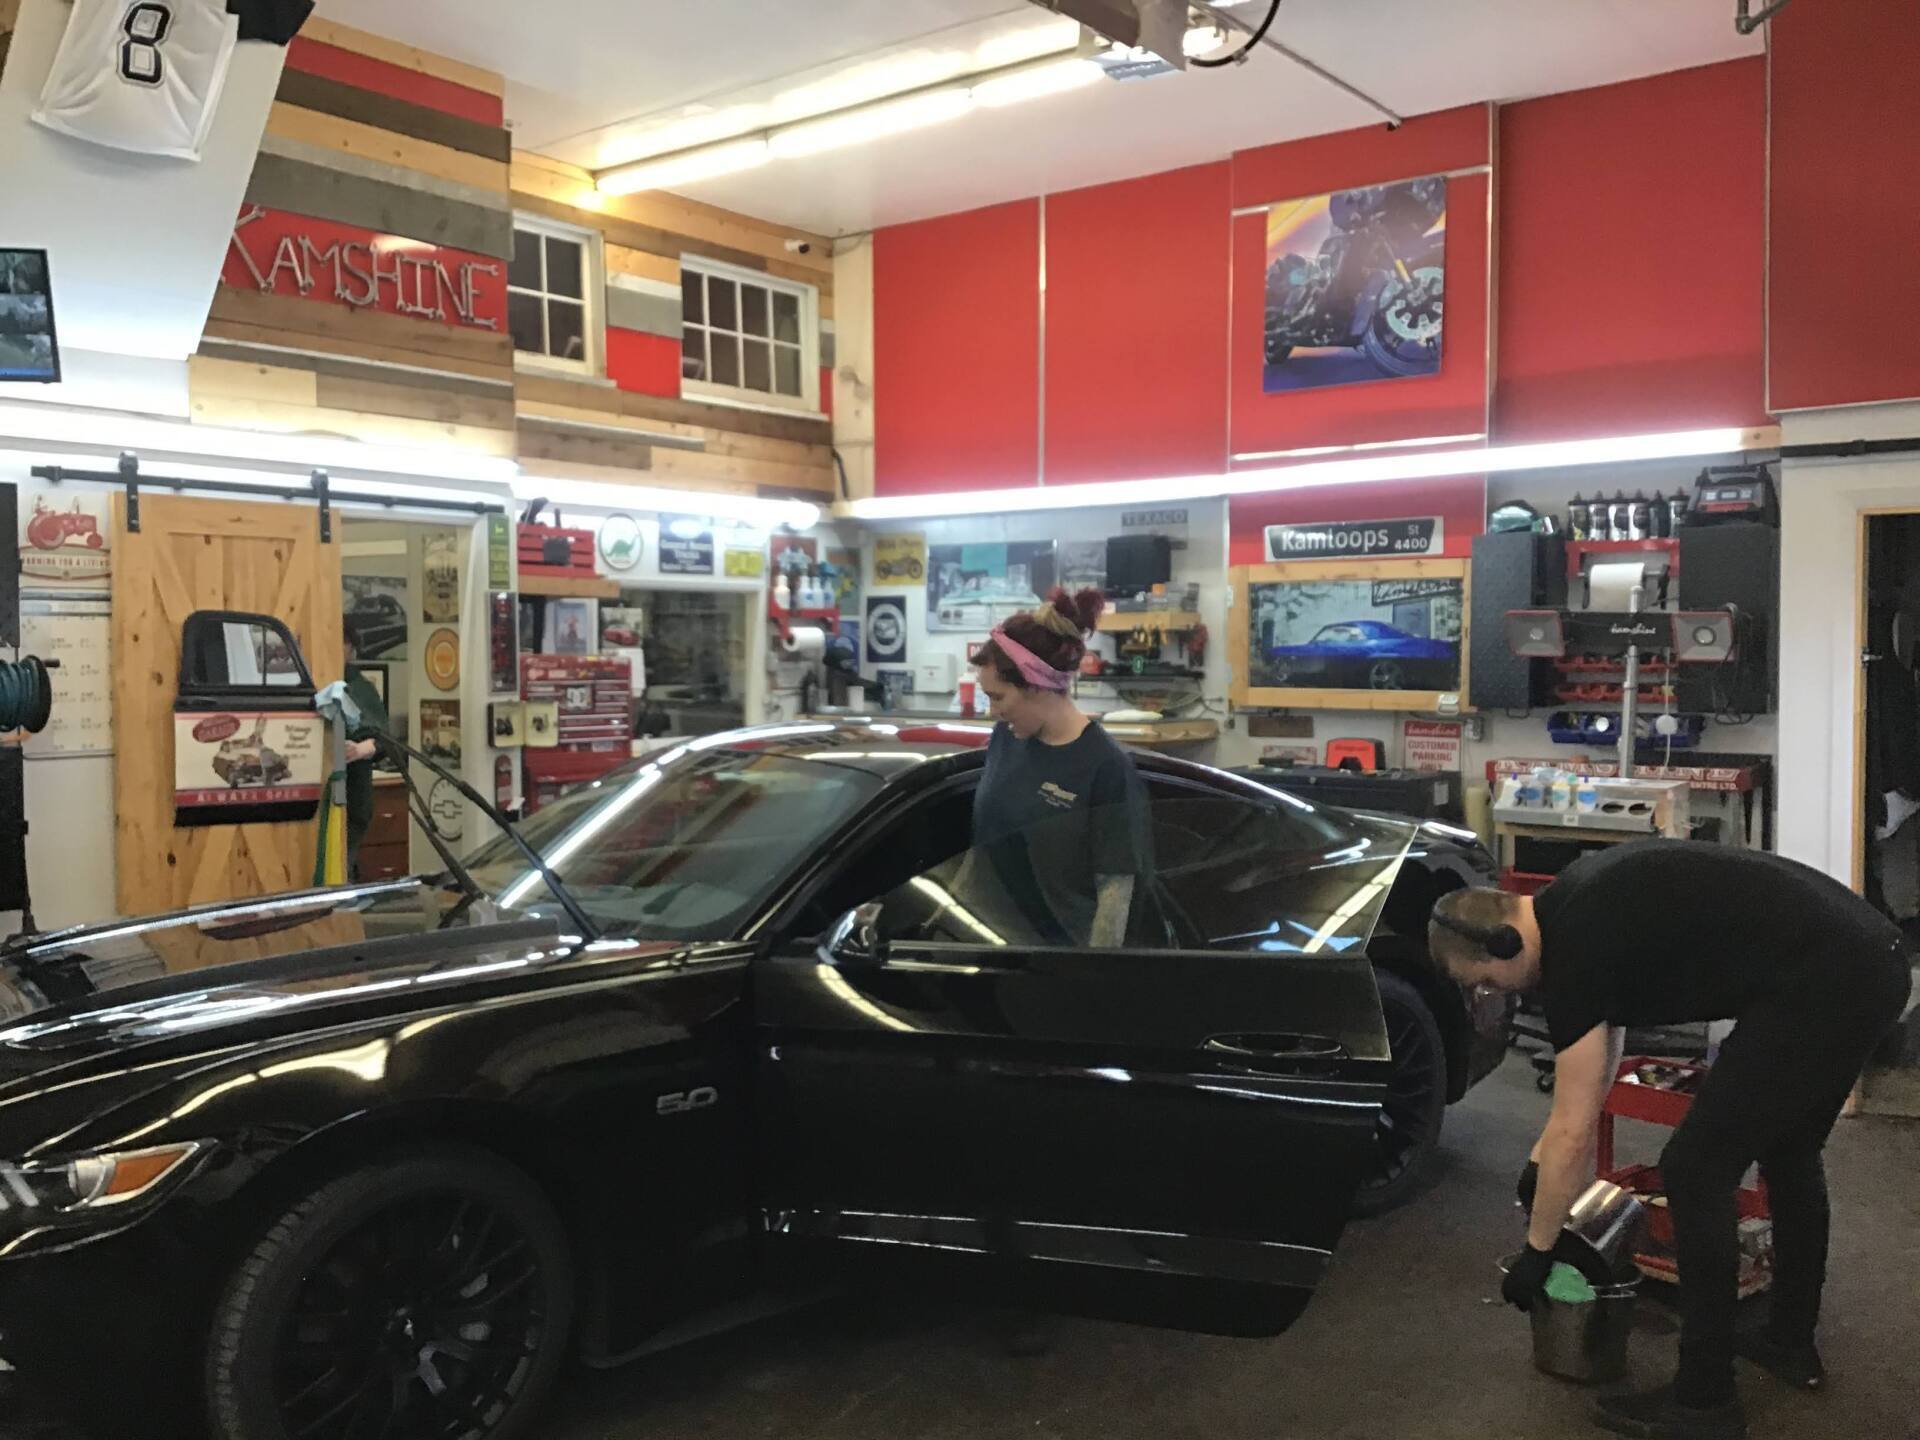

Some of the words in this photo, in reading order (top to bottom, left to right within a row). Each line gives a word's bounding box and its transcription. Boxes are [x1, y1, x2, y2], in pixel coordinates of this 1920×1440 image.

[116, 1, 175, 88] 8
[1407, 524, 1420, 536] St
[1281, 528, 1389, 552] Kamloops
[1394, 537, 1428, 550] 4400
[1407, 740, 1457, 751] CUSTOMER
[1411, 751, 1453, 761] PARKING
